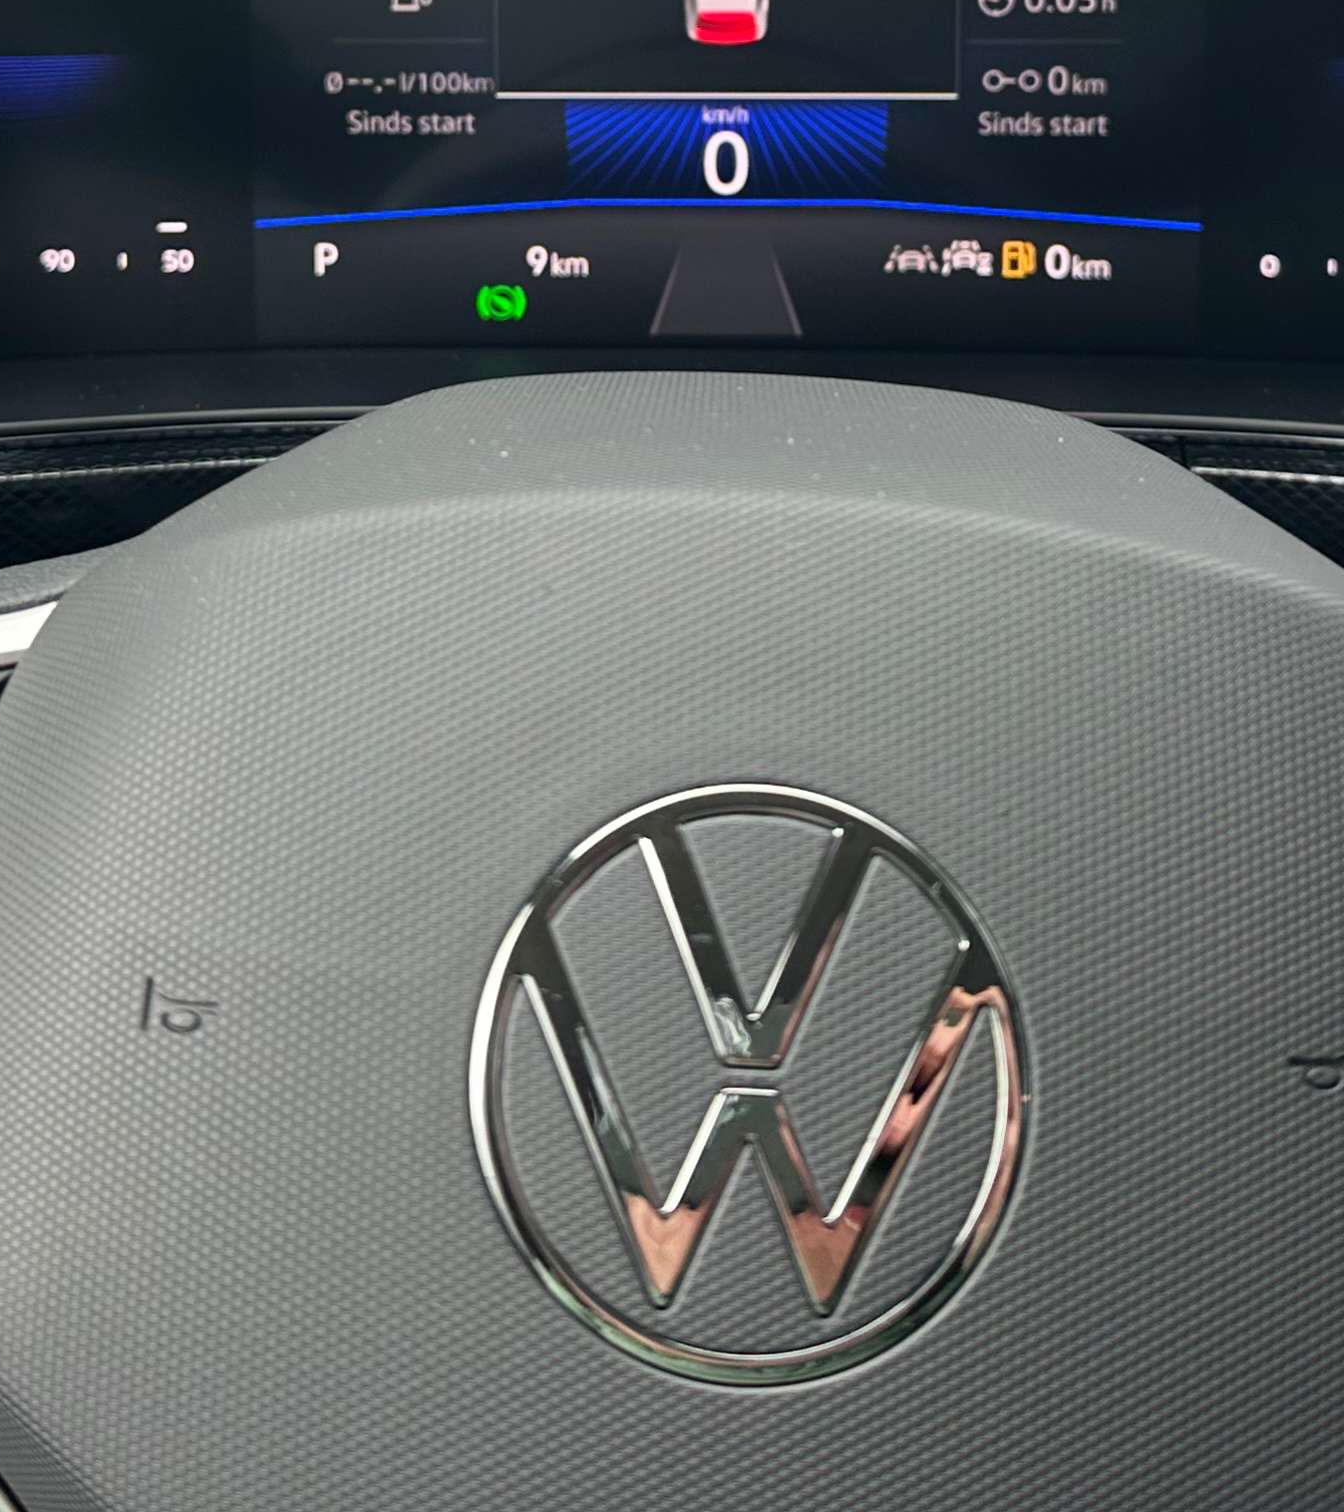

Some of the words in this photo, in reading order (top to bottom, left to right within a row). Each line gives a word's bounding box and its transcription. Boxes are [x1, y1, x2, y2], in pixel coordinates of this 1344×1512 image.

[346, 109, 413, 135] Sinds
[418, 112, 477, 135] start
[978, 110, 1045, 137] Sinds
[1049, 113, 1109, 137] start
[703, 129, 750, 197] 0
[39, 248, 76, 274] 90
[160, 248, 195, 274] 50
[313, 242, 340, 278] P
[1259, 253, 1281, 279] 0
